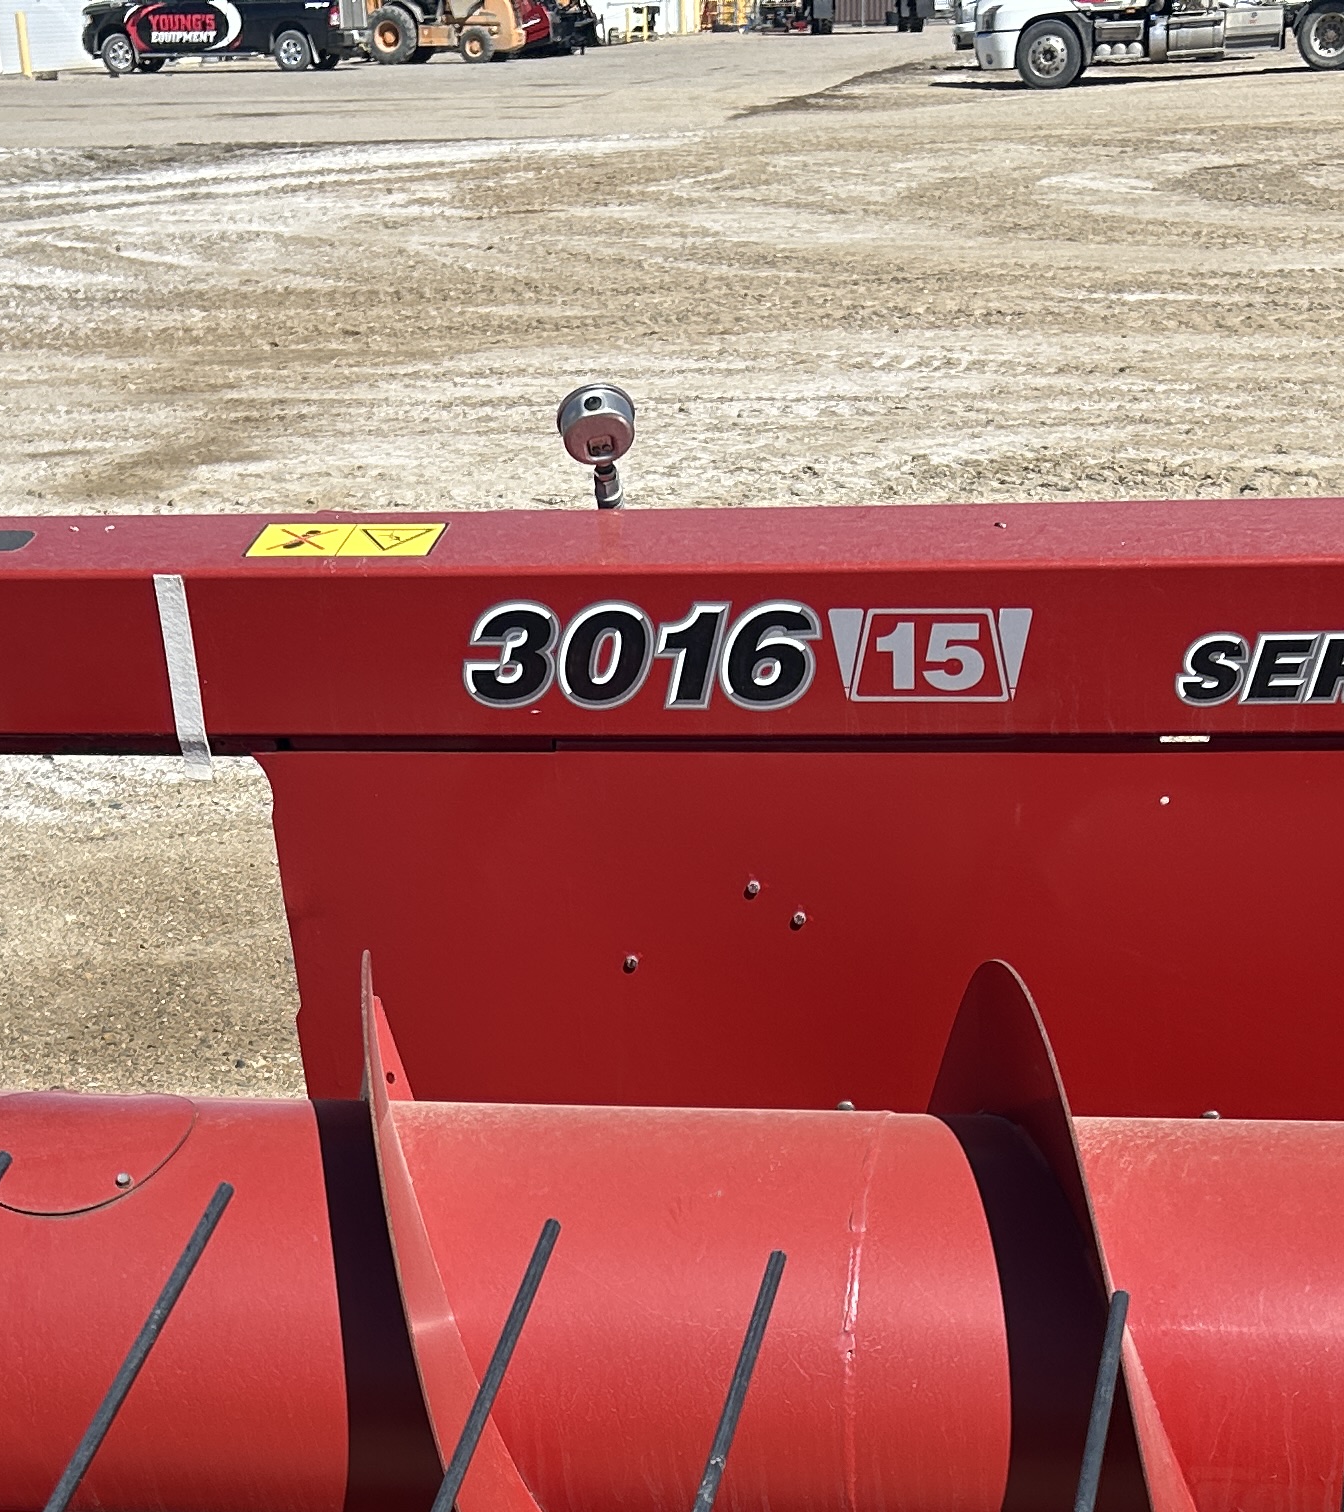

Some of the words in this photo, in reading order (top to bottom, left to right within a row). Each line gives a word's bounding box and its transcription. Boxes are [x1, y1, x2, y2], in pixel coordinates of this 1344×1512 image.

[148, 14, 215, 31] YOUNG'S
[151, 30, 217, 43] EQUIPMENT
[462, 600, 823, 711] 3016
[876, 622, 986, 691] 15
